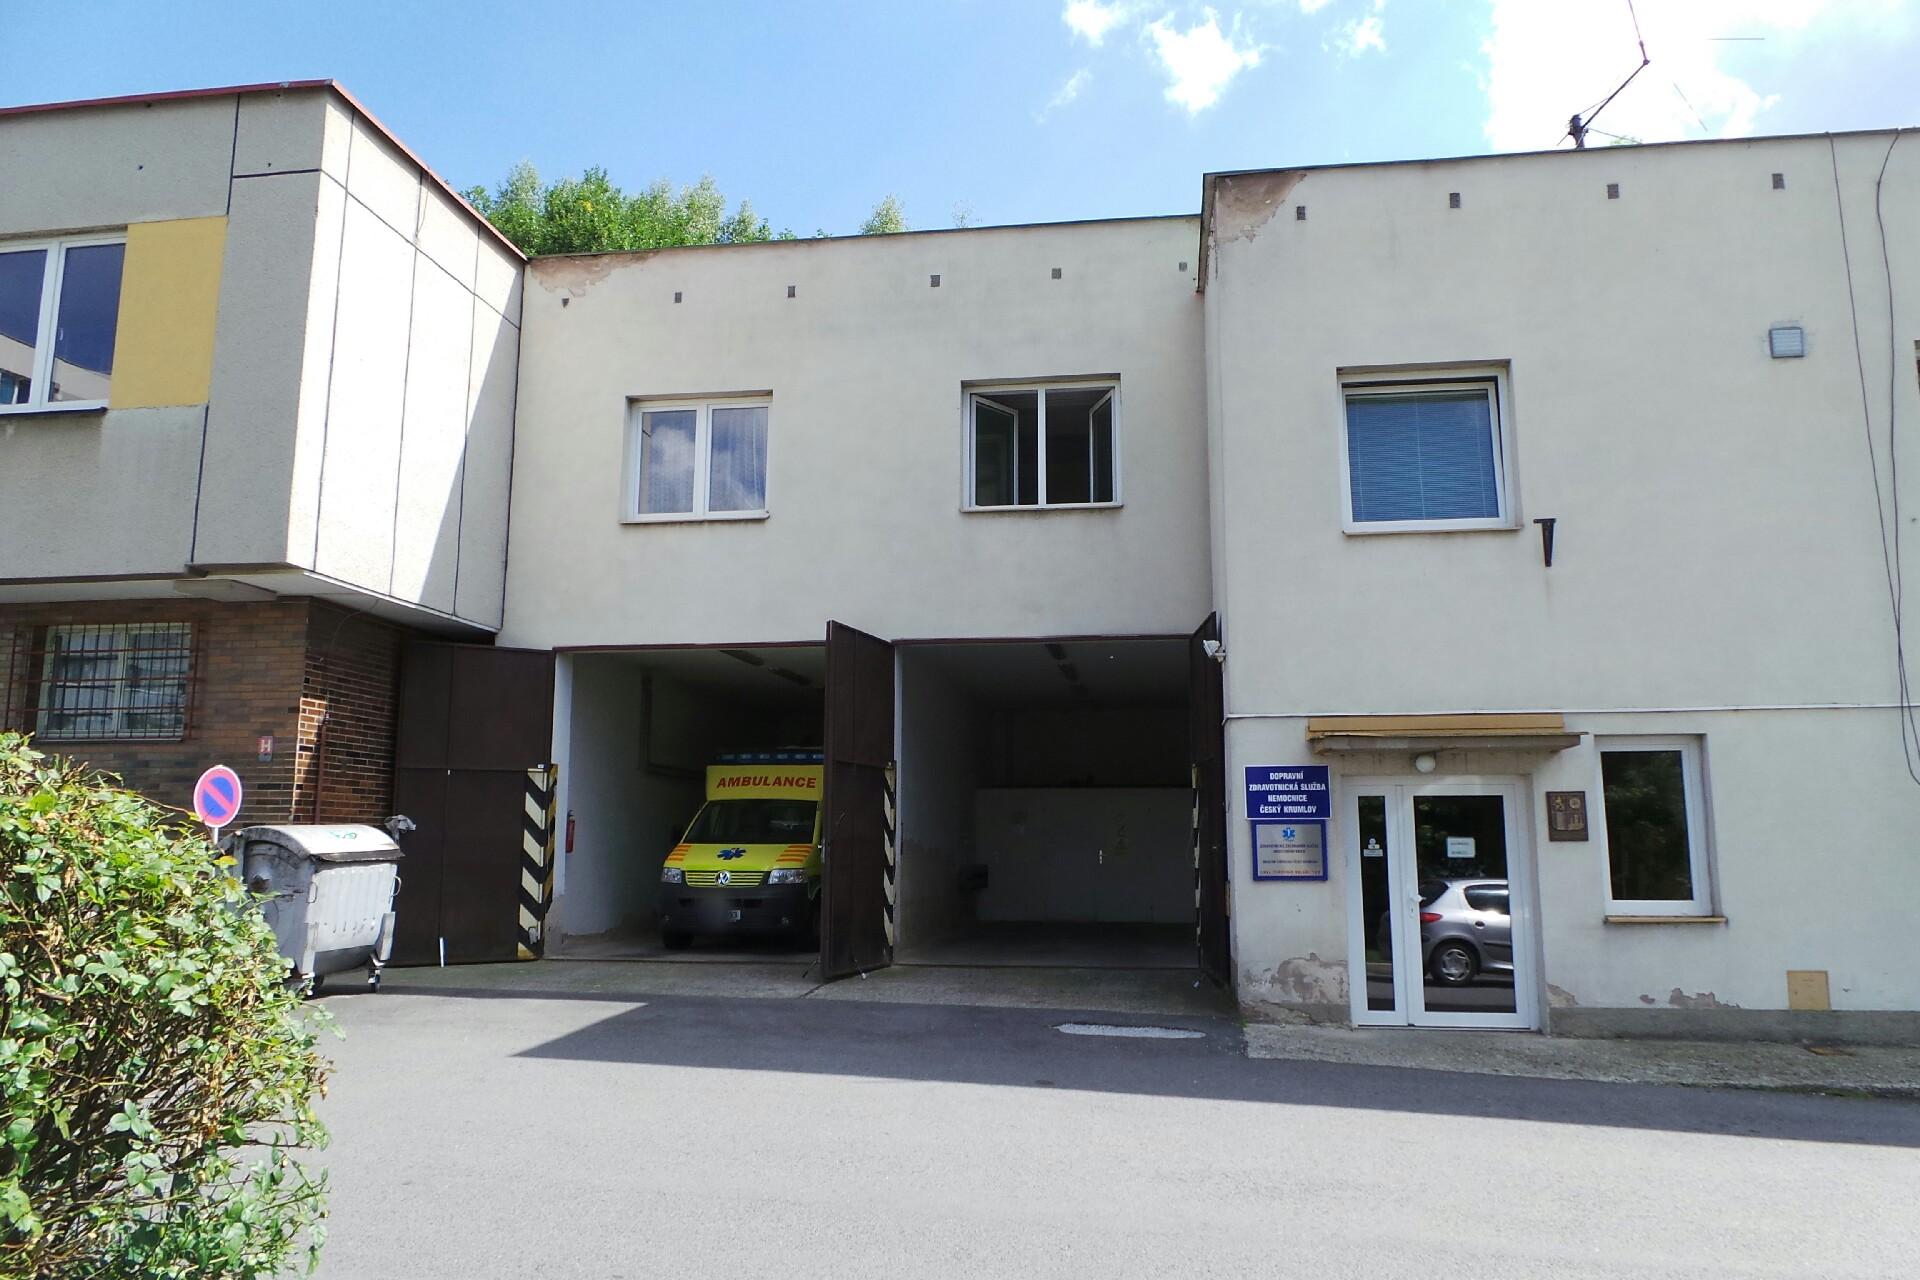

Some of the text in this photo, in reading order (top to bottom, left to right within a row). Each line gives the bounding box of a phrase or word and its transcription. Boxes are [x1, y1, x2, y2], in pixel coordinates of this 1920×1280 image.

[1269, 771, 1304, 780] DOPRAVNÍ
[716, 775, 817, 789] AMBULANCE
[1248, 781, 1326, 791] ZDRAVOTNICKÁ SLUŽBA
[1267, 794, 1308, 802] NEMOCNICE
[1259, 804, 1317, 813] ČESKÝ KRUMLOV
